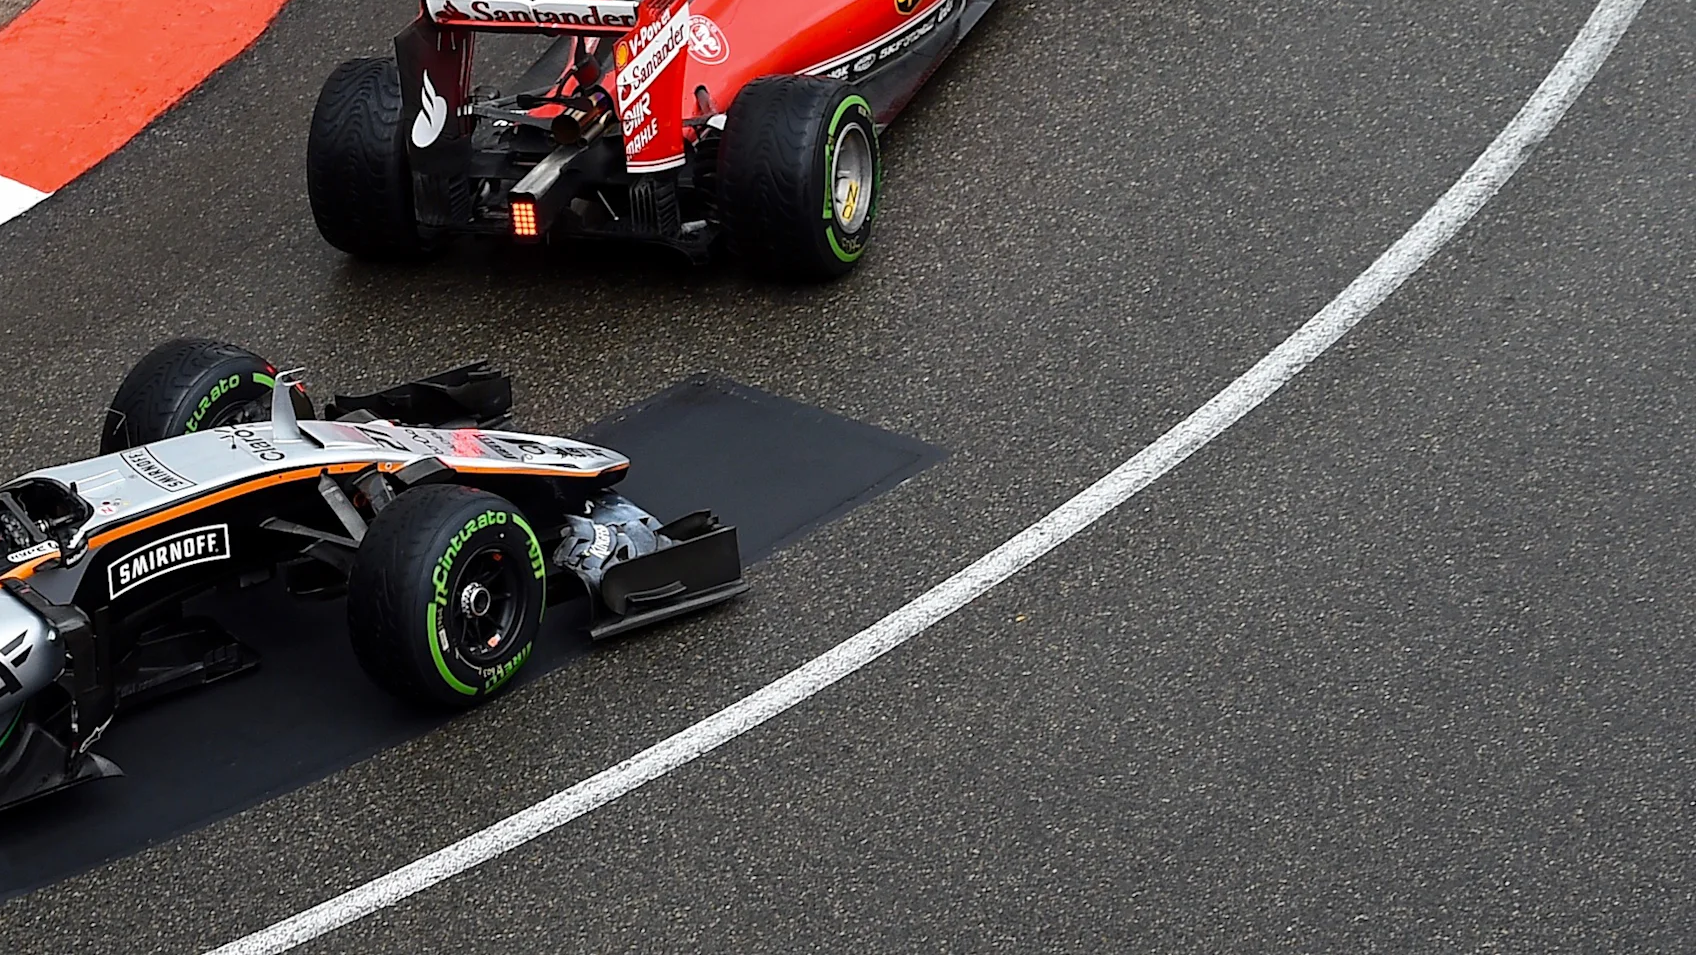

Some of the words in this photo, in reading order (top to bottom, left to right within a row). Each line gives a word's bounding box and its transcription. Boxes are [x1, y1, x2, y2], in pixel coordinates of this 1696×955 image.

[470, 0, 635, 27] Santander
[632, 23, 685, 91] Santander
[118, 532, 220, 585] SMIRNOFF
